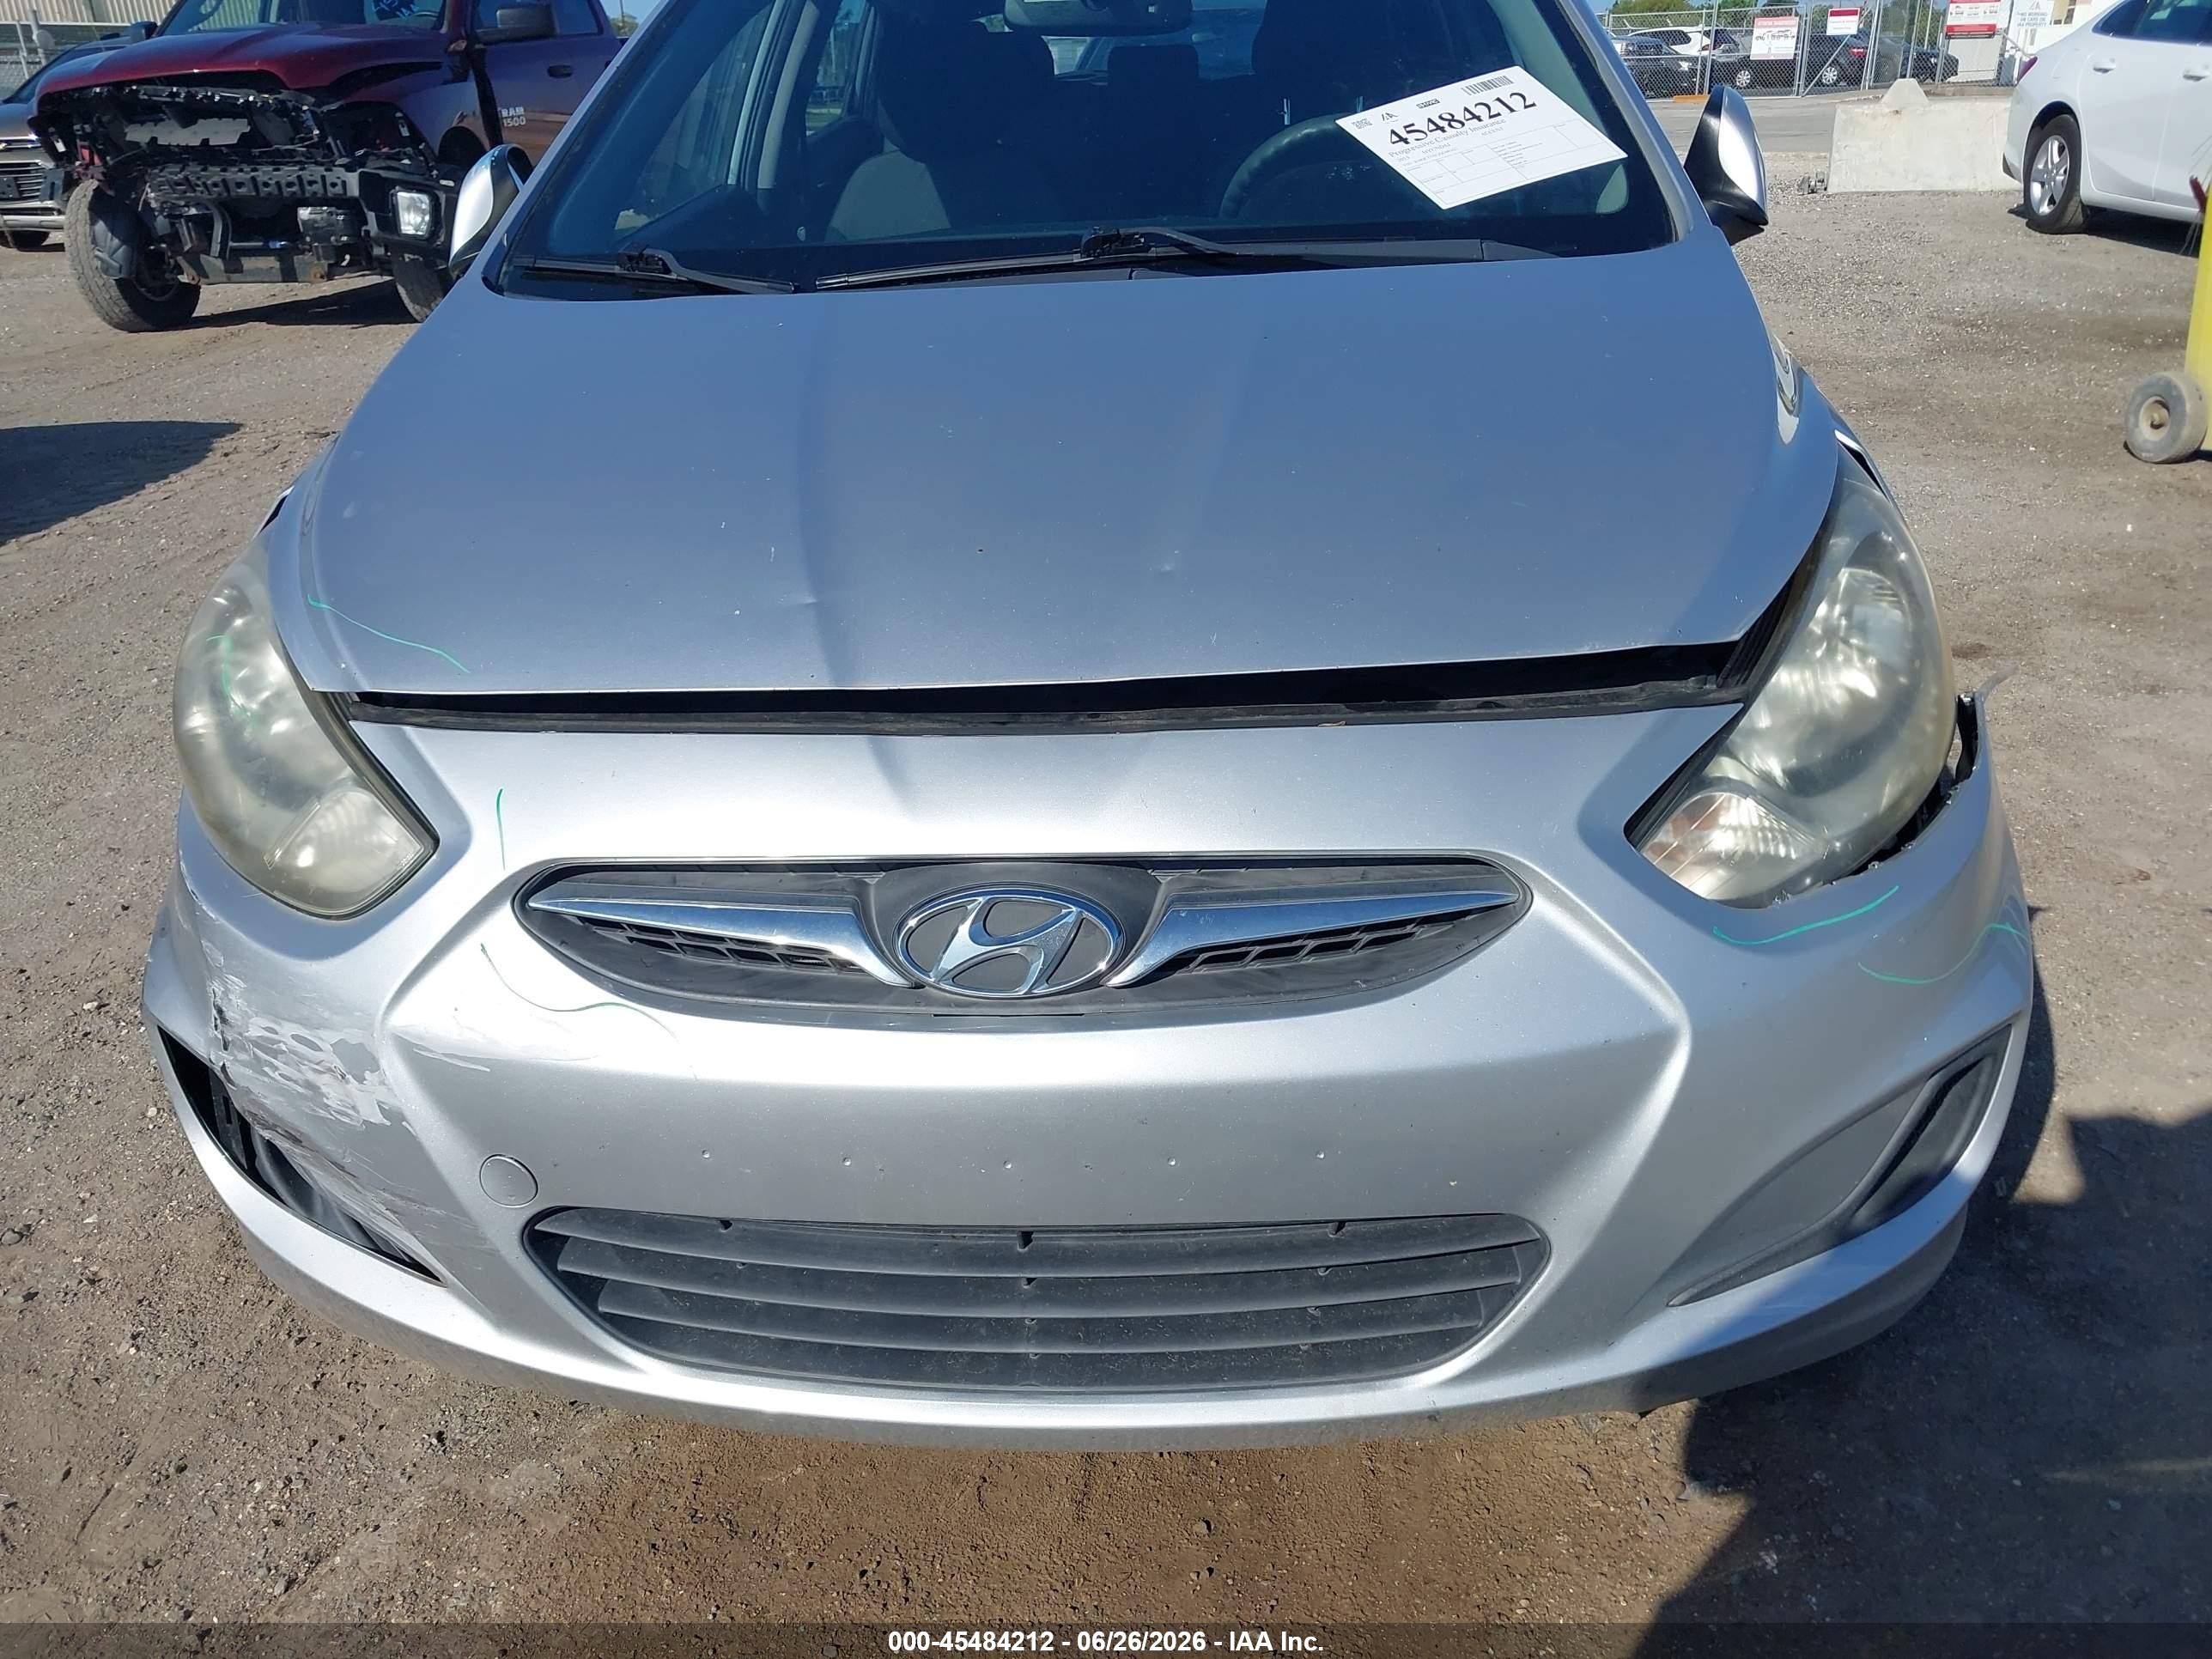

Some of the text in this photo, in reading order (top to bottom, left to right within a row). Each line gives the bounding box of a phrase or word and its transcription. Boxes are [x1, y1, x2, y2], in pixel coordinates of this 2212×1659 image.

[501, 106, 525, 118] RAM
[1389, 92, 1537, 146] 45484212
[503, 116, 526, 127] 1500
[1389, 139, 1435, 158] Progressive
